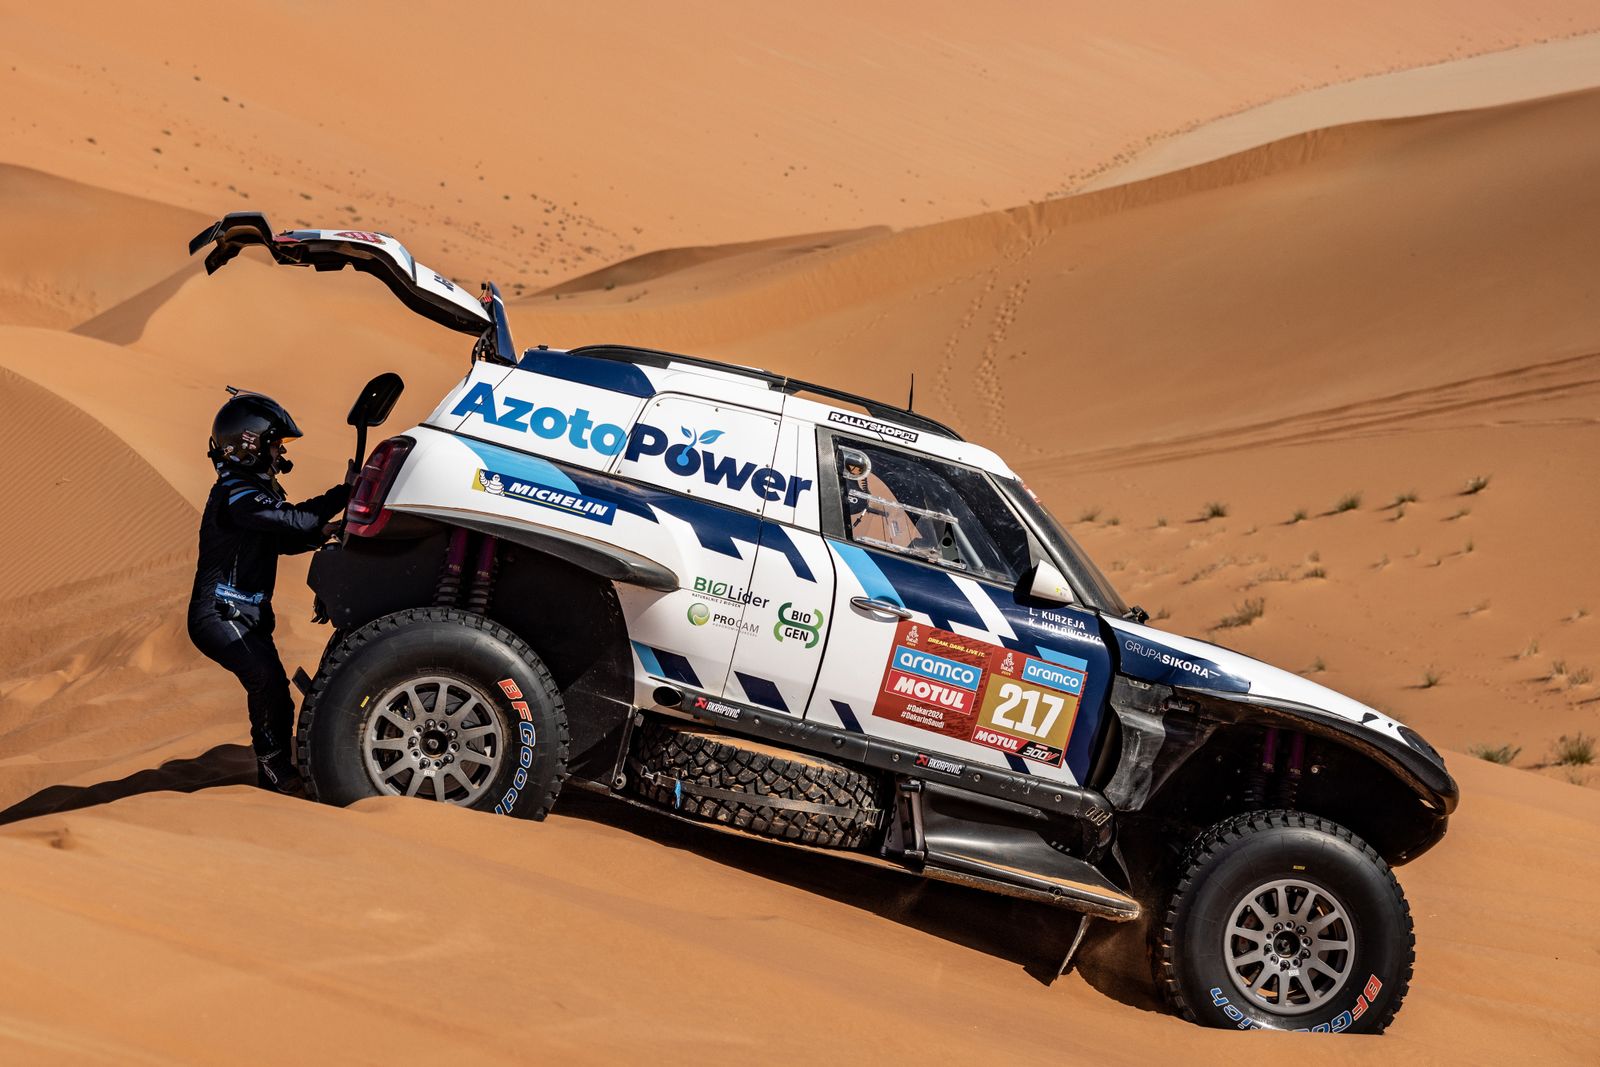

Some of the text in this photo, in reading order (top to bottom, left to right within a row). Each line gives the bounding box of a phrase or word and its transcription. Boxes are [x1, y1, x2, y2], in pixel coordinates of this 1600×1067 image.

[450, 381, 813, 507] AzotoPower
[508, 481, 609, 516] MICHELIN
[712, 613, 760, 634] PROCAM
[791, 610, 812, 624] BIO
[1029, 607, 1086, 630] L. KURZEJA
[784, 627, 809, 642] GEN
[900, 652, 975, 684] aramco
[1124, 640, 1209, 679] GRUPASIKORA
[1027, 665, 1079, 688] aramco
[893, 676, 965, 709] MOTUL
[906, 703, 944, 720] #Dakar2024
[991, 683, 1065, 739] 217
[975, 729, 1020, 750] MOTUL
